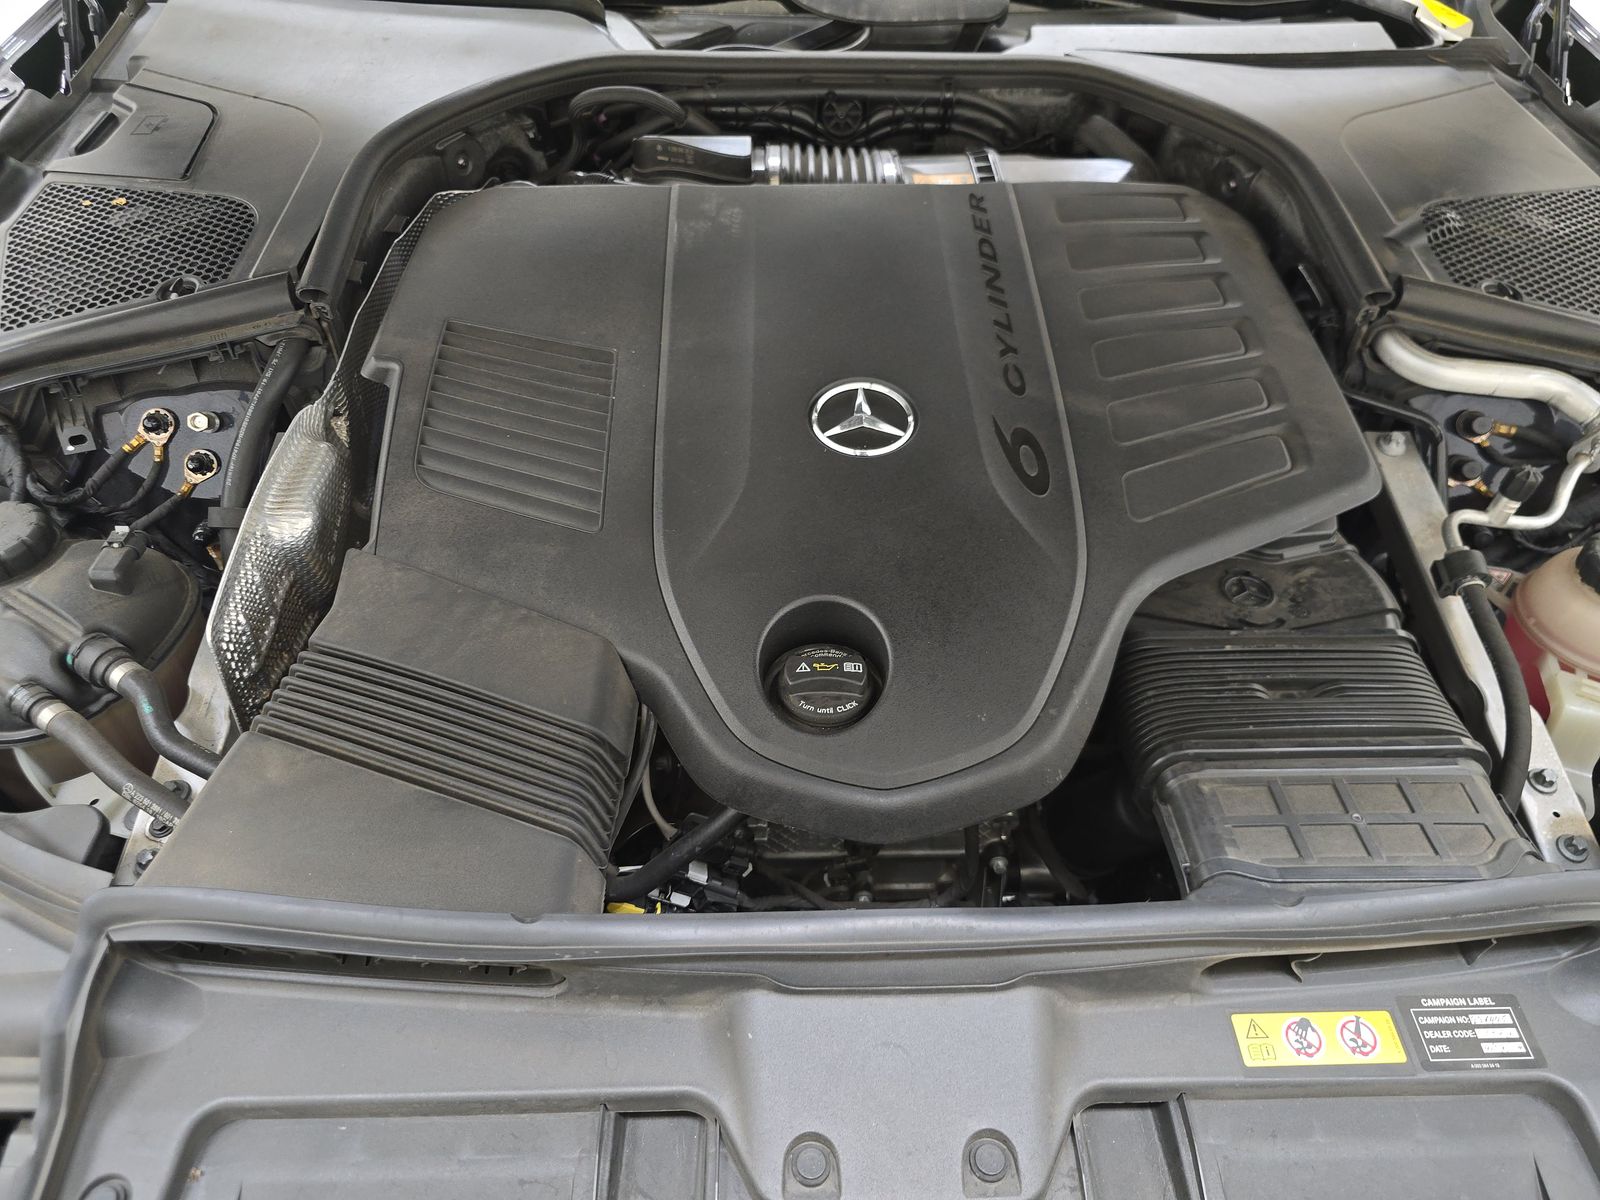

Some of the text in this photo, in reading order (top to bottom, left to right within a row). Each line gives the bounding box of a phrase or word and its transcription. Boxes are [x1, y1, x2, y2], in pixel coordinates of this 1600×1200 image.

[969, 193, 1050, 496] 6 CYLINDER
[799, 700, 815, 712] Turn
[836, 700, 859, 713] CLICK
[1420, 997, 1496, 1007] CAMPAIGN LABEL
[1418, 1016, 1455, 1025] CAMPAIGN
[1456, 1016, 1471, 1024] NO:
[1423, 1030, 1453, 1039] DEALER
[1453, 1029, 1477, 1038] CODE:
[1429, 1044, 1451, 1053] DATE:
